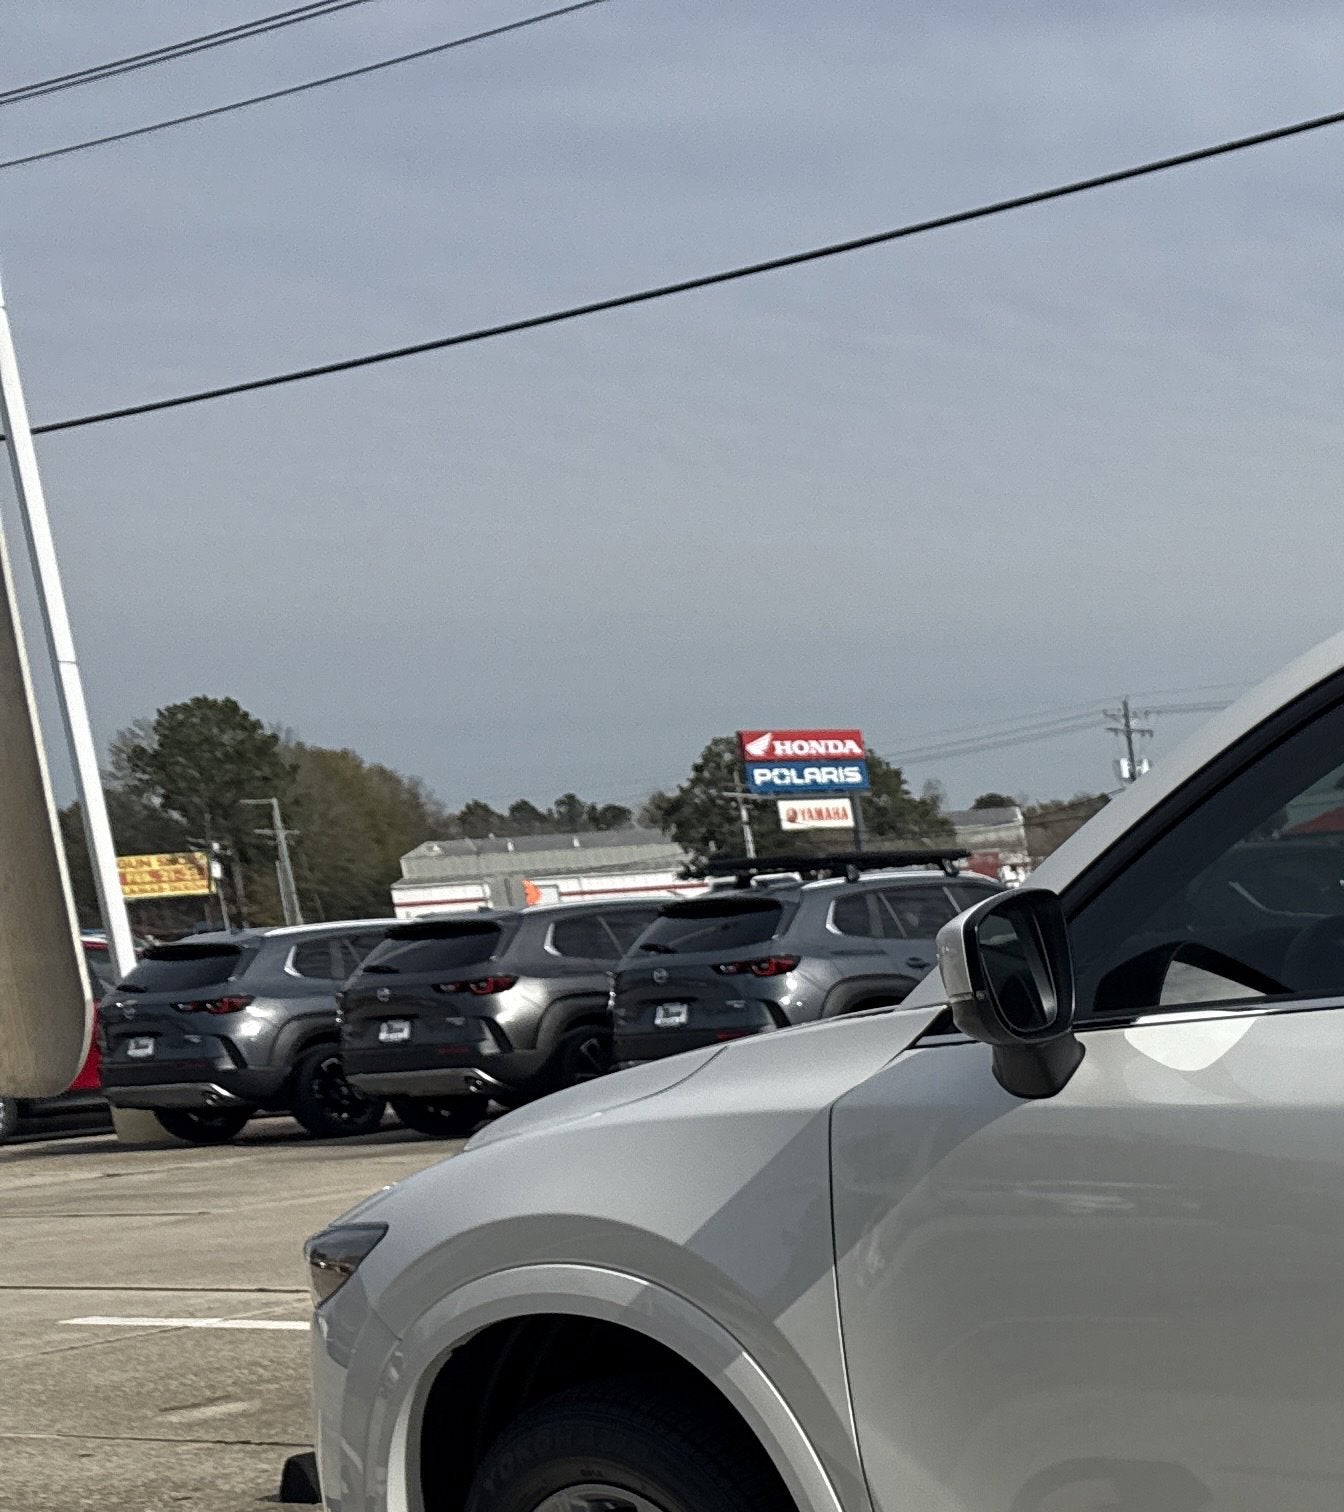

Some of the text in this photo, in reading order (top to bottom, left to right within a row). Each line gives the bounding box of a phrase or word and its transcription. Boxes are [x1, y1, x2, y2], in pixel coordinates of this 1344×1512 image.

[773, 739, 862, 756] HONDA
[752, 766, 862, 786] POLARIS
[801, 806, 849, 821] YAMAHA
